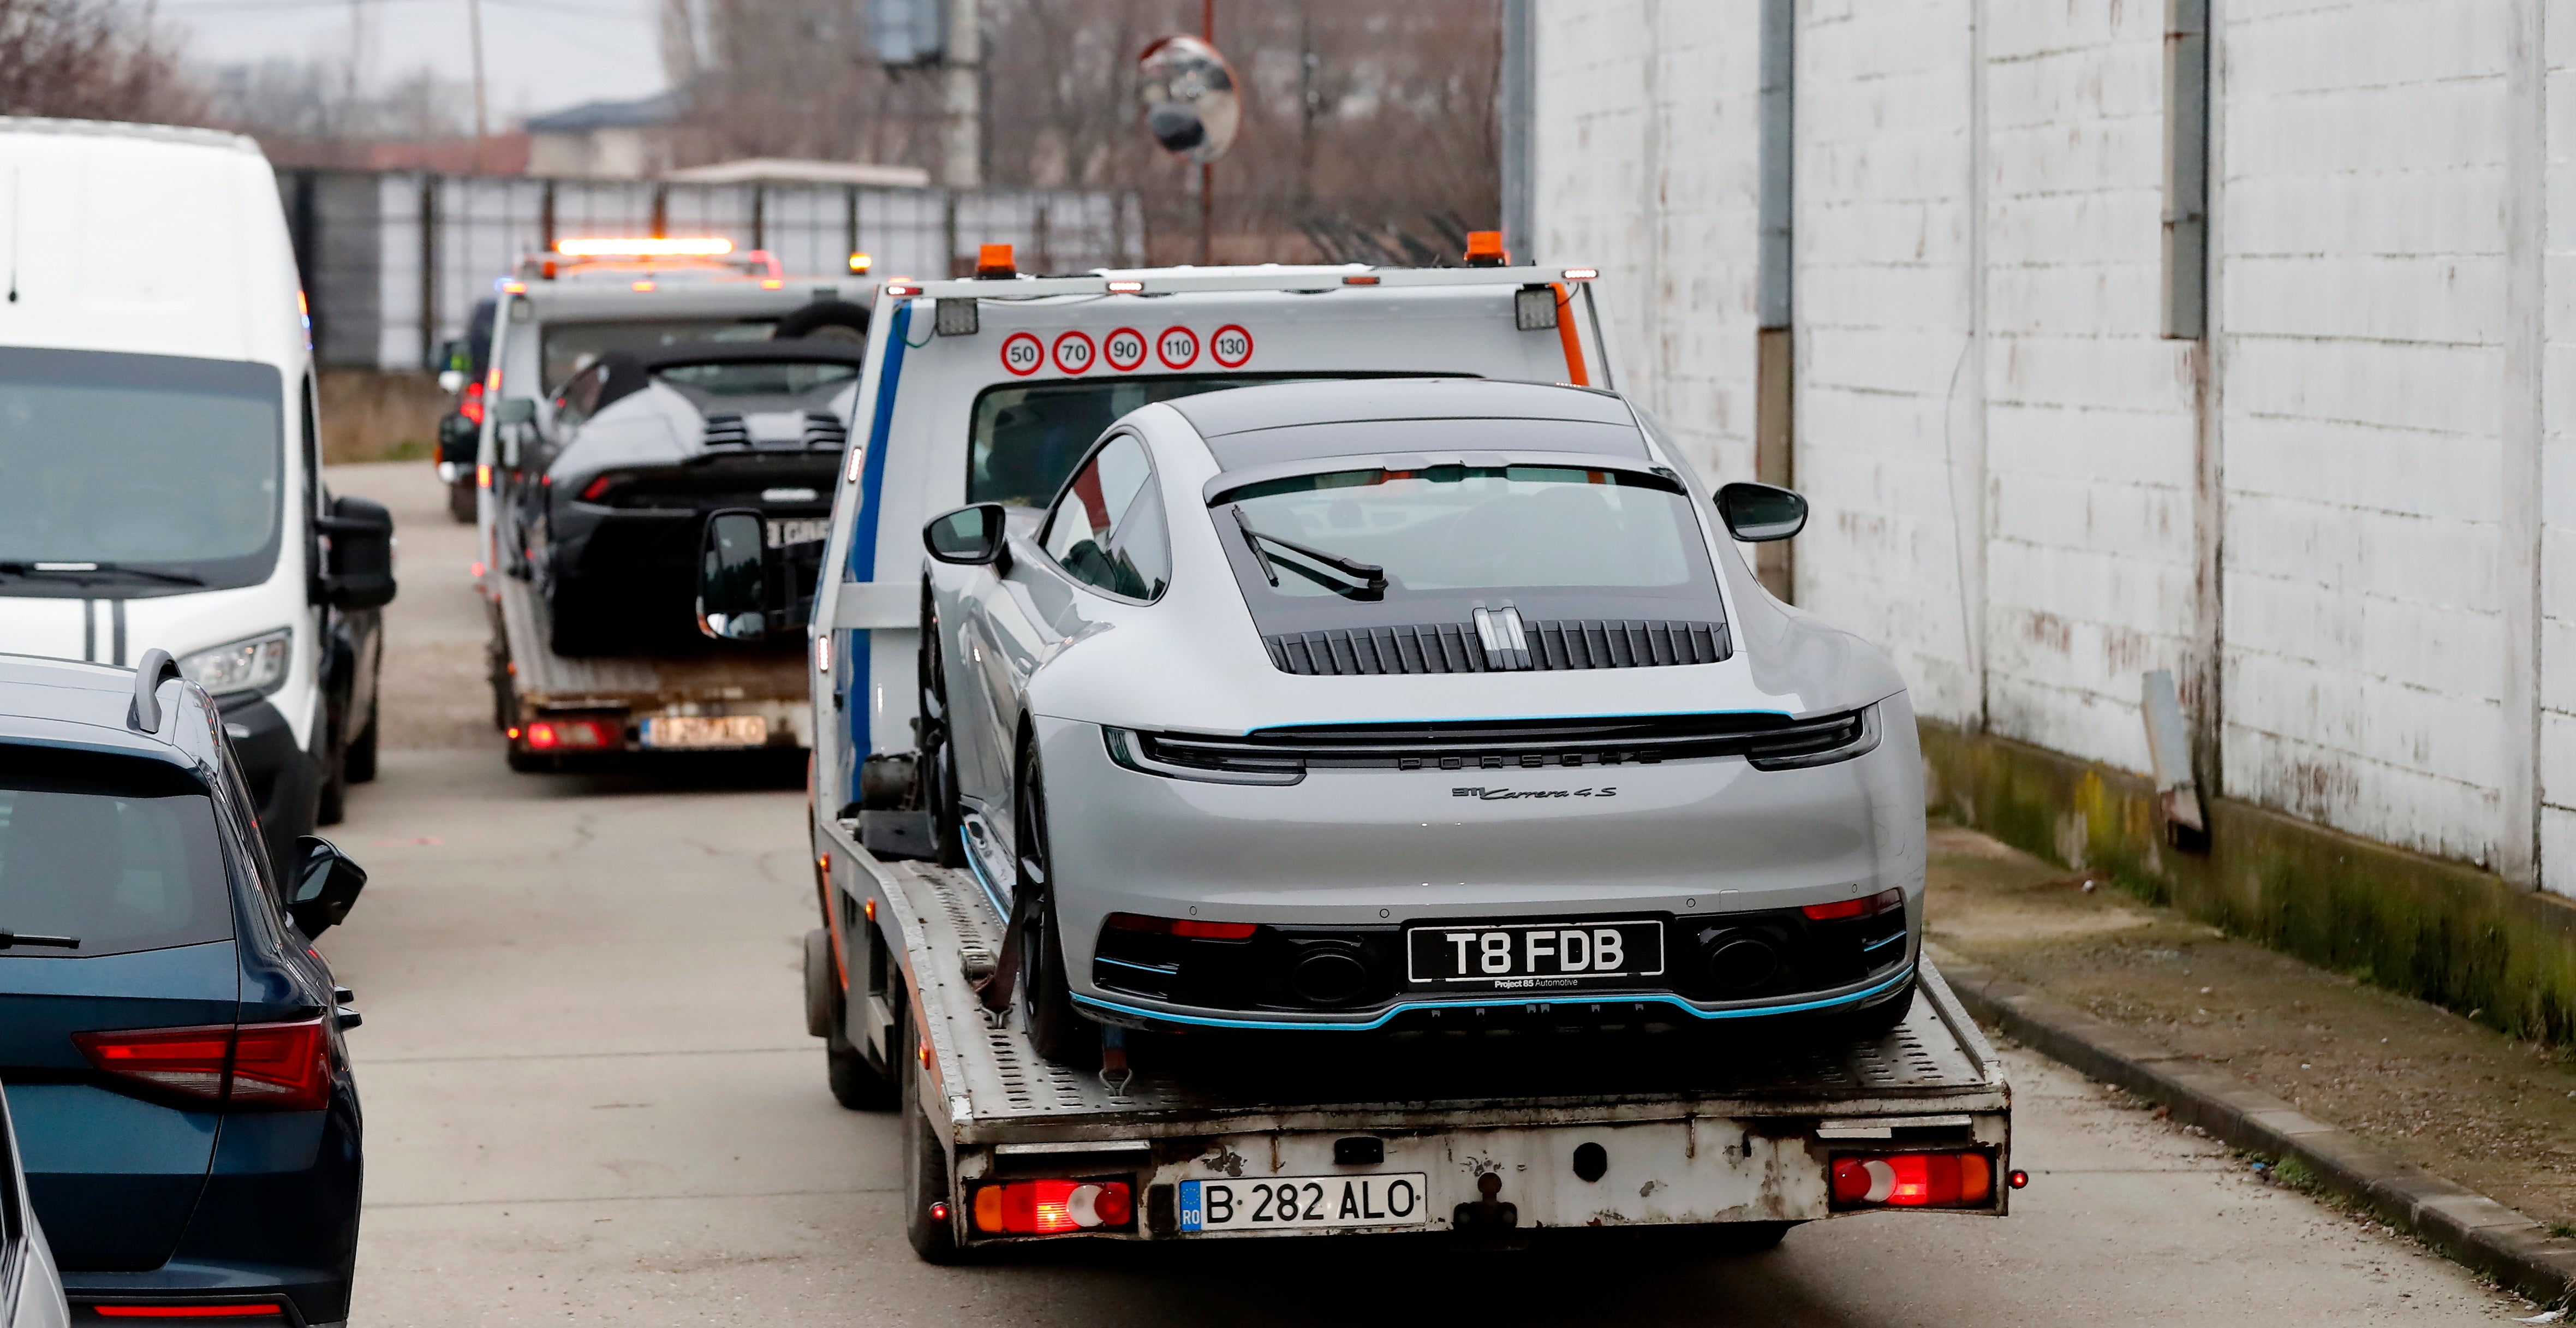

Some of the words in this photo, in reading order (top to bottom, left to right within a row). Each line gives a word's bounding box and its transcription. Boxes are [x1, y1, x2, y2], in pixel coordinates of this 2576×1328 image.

[1011, 346, 1035, 363] 50
[1063, 344, 1087, 361] 70
[1113, 341, 1137, 358] 90
[1165, 340, 1191, 356] 110
[1218, 338, 1245, 355] 130
[1399, 751, 1662, 770] PORSCHE
[1480, 788, 1569, 800] Carrera
[1573, 788, 1592, 797] 4
[1595, 787, 1617, 796] S
[1446, 932, 1511, 975] T8
[1525, 928, 1624, 973] FDB
[1494, 980, 1522, 989] Project
[1535, 979, 1578, 987] Automotive
[1206, 1185, 1233, 1224] B
[1251, 1183, 1325, 1222] 282
[1339, 1179, 1415, 1220] ALO
[1183, 1210, 1200, 1225] RO
